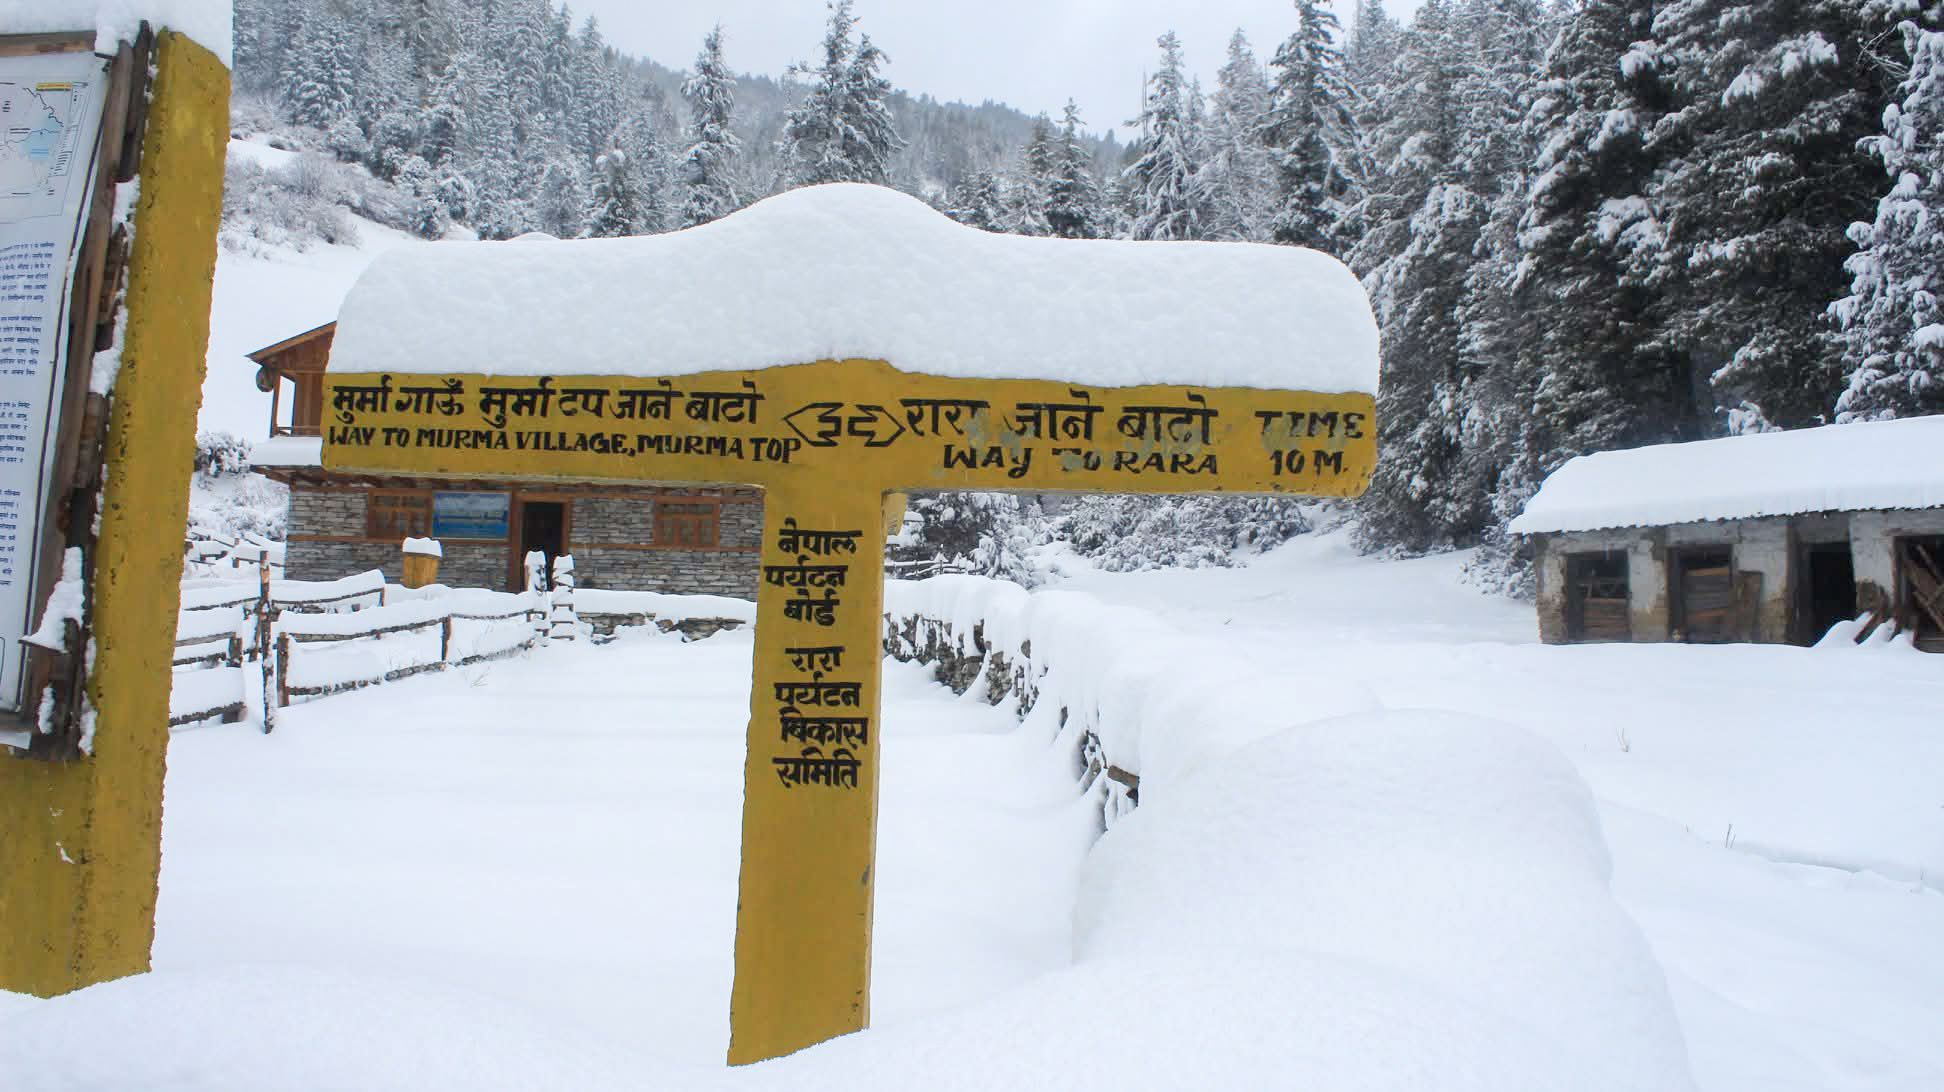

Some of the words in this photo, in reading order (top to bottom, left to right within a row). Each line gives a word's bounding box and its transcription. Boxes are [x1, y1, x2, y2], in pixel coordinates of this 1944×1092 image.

[686, 376, 766, 424] बाटो
[1003, 388, 1104, 441] जाने
[1117, 388, 1218, 445] बाटो
[1254, 410, 1366, 439] TIME
[329, 426, 376, 446] WAY
[382, 427, 411, 448] TO
[415, 428, 510, 449] MURMA
[636, 433, 744, 459] MURMA
[750, 436, 802, 463] TOP
[1052, 448, 1099, 472] TO
[1113, 450, 1218, 475] RARA
[777, 517, 863, 555] नेपाल
[764, 556, 848, 587] पर्यटन
[783, 589, 840, 626] बोर्ड
[785, 646, 845, 672] रारा
[774, 671, 862, 708] पर्यटन
[772, 746, 861, 788] समिति
